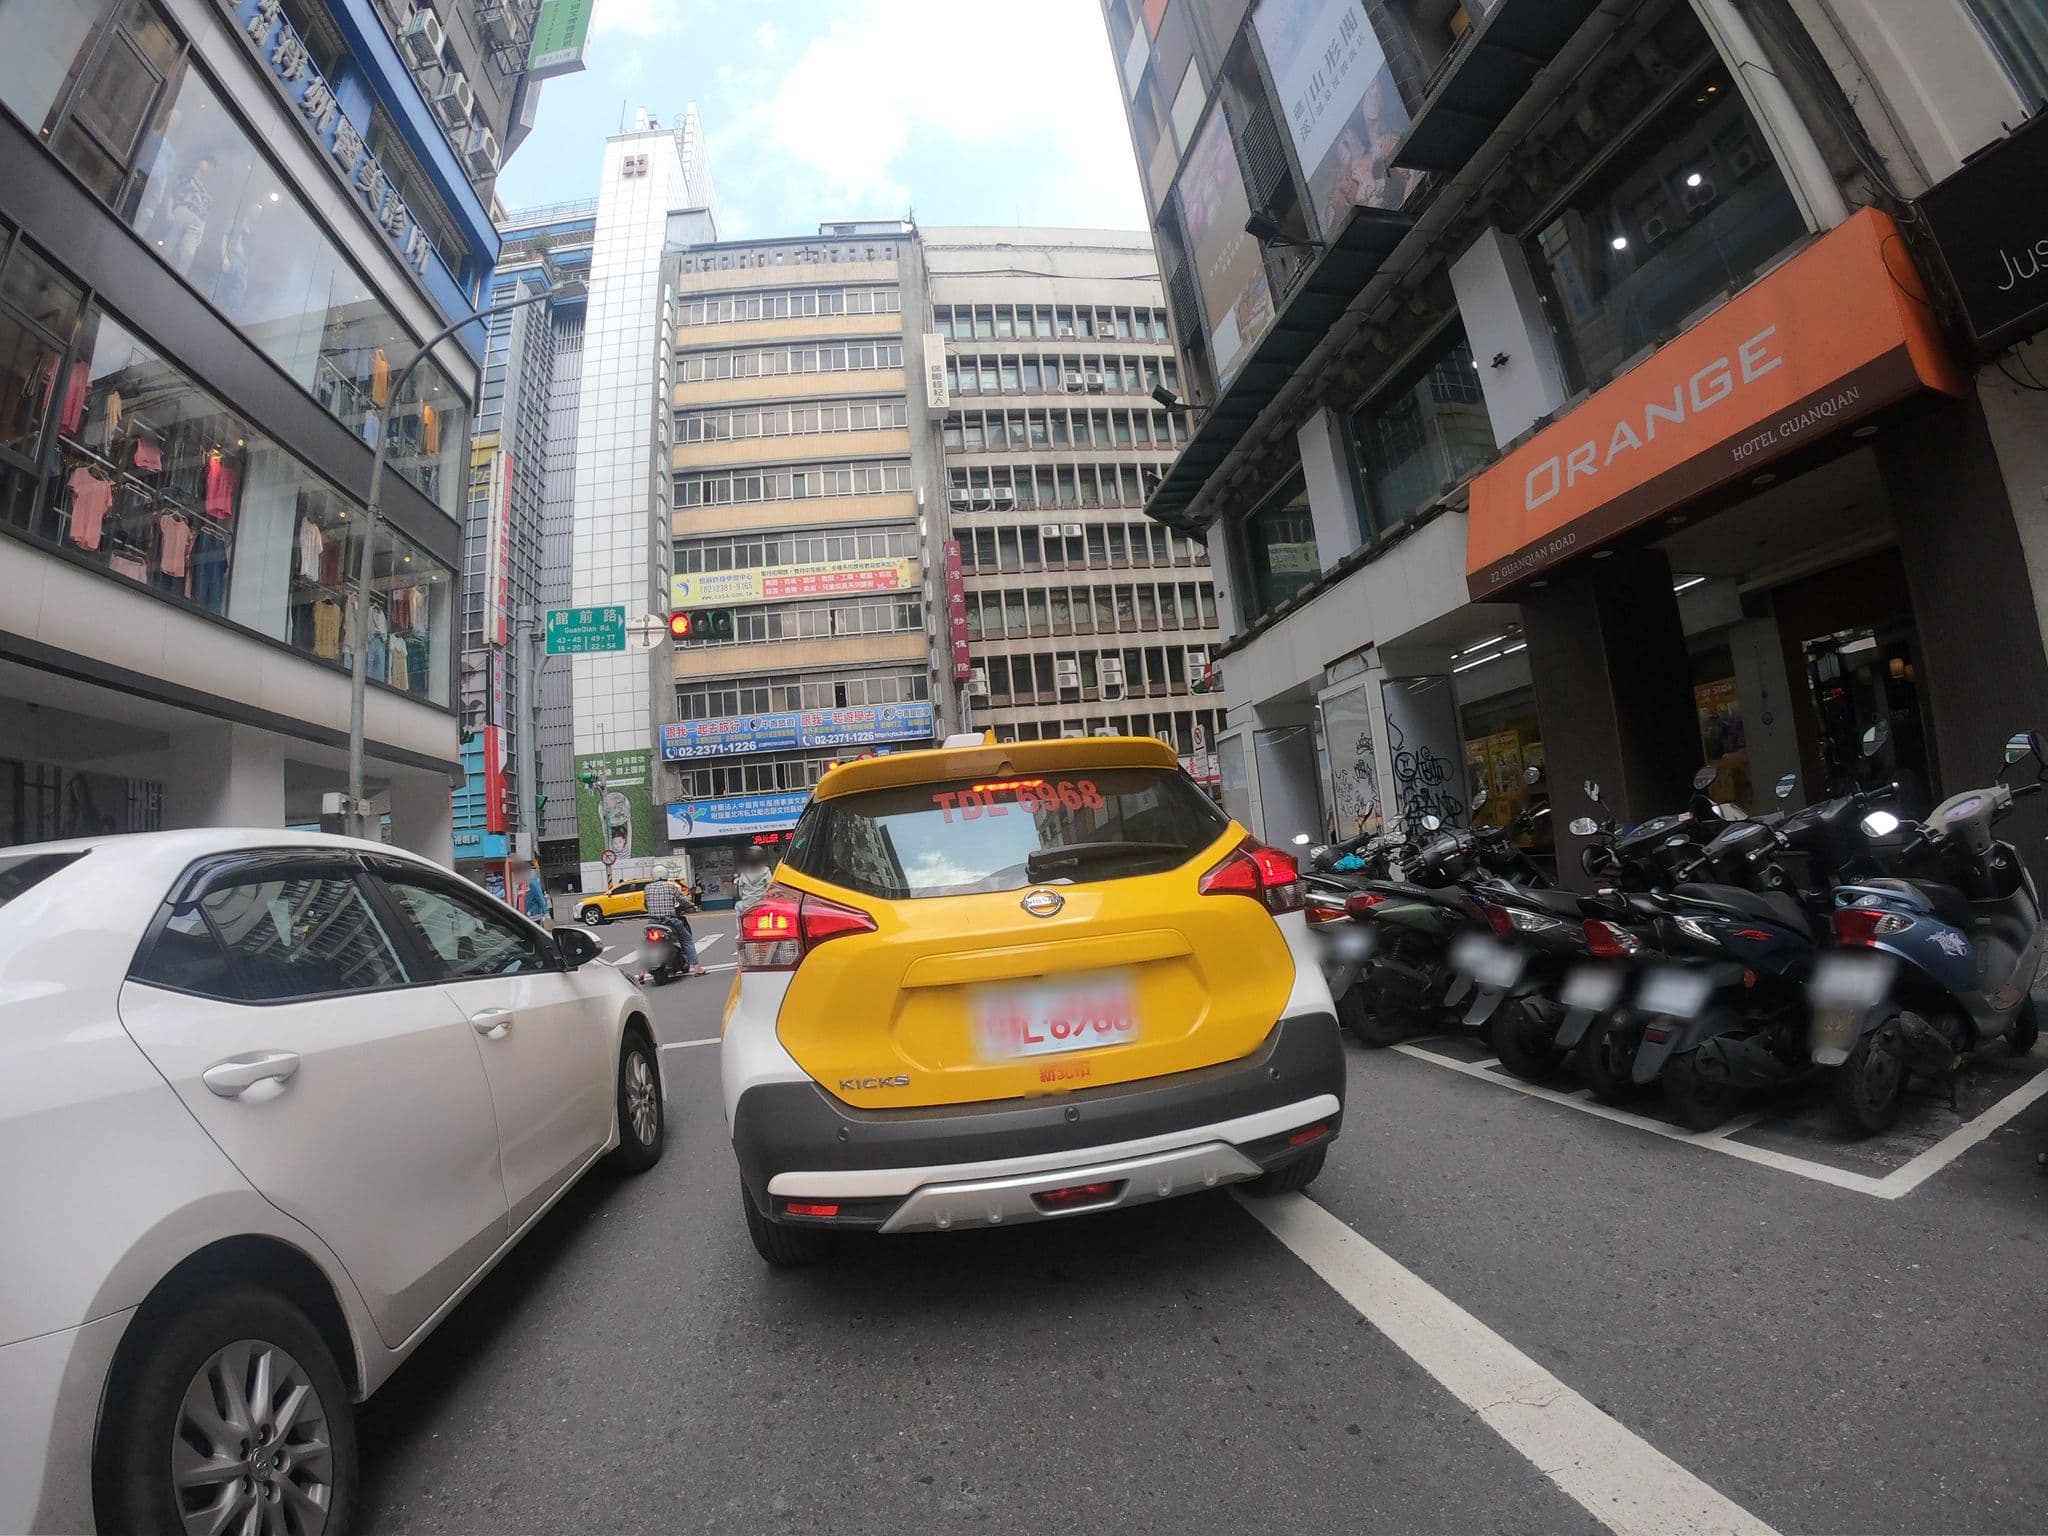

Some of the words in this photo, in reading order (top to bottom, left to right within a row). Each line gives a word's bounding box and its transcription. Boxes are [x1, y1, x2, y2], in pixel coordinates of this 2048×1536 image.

[931, 365, 944, 405] 保險經紀人
[1525, 324, 1784, 511] ORANGE
[1732, 431, 1777, 462] HOTEL
[1780, 386, 1860, 437] GUANQIAN
[1489, 568, 1501, 584] 22
[1501, 546, 1548, 577] GUANQIAN
[1549, 533, 1576, 554] ROAD
[556, 609, 617, 625] 館前路
[678, 741, 757, 757] 02-2371-1226
[814, 732, 874, 745] 02-2371-1226
[932, 789, 1009, 824] TDL
[1015, 780, 1104, 814] 6968
[839, 1074, 910, 1090] KICKS
